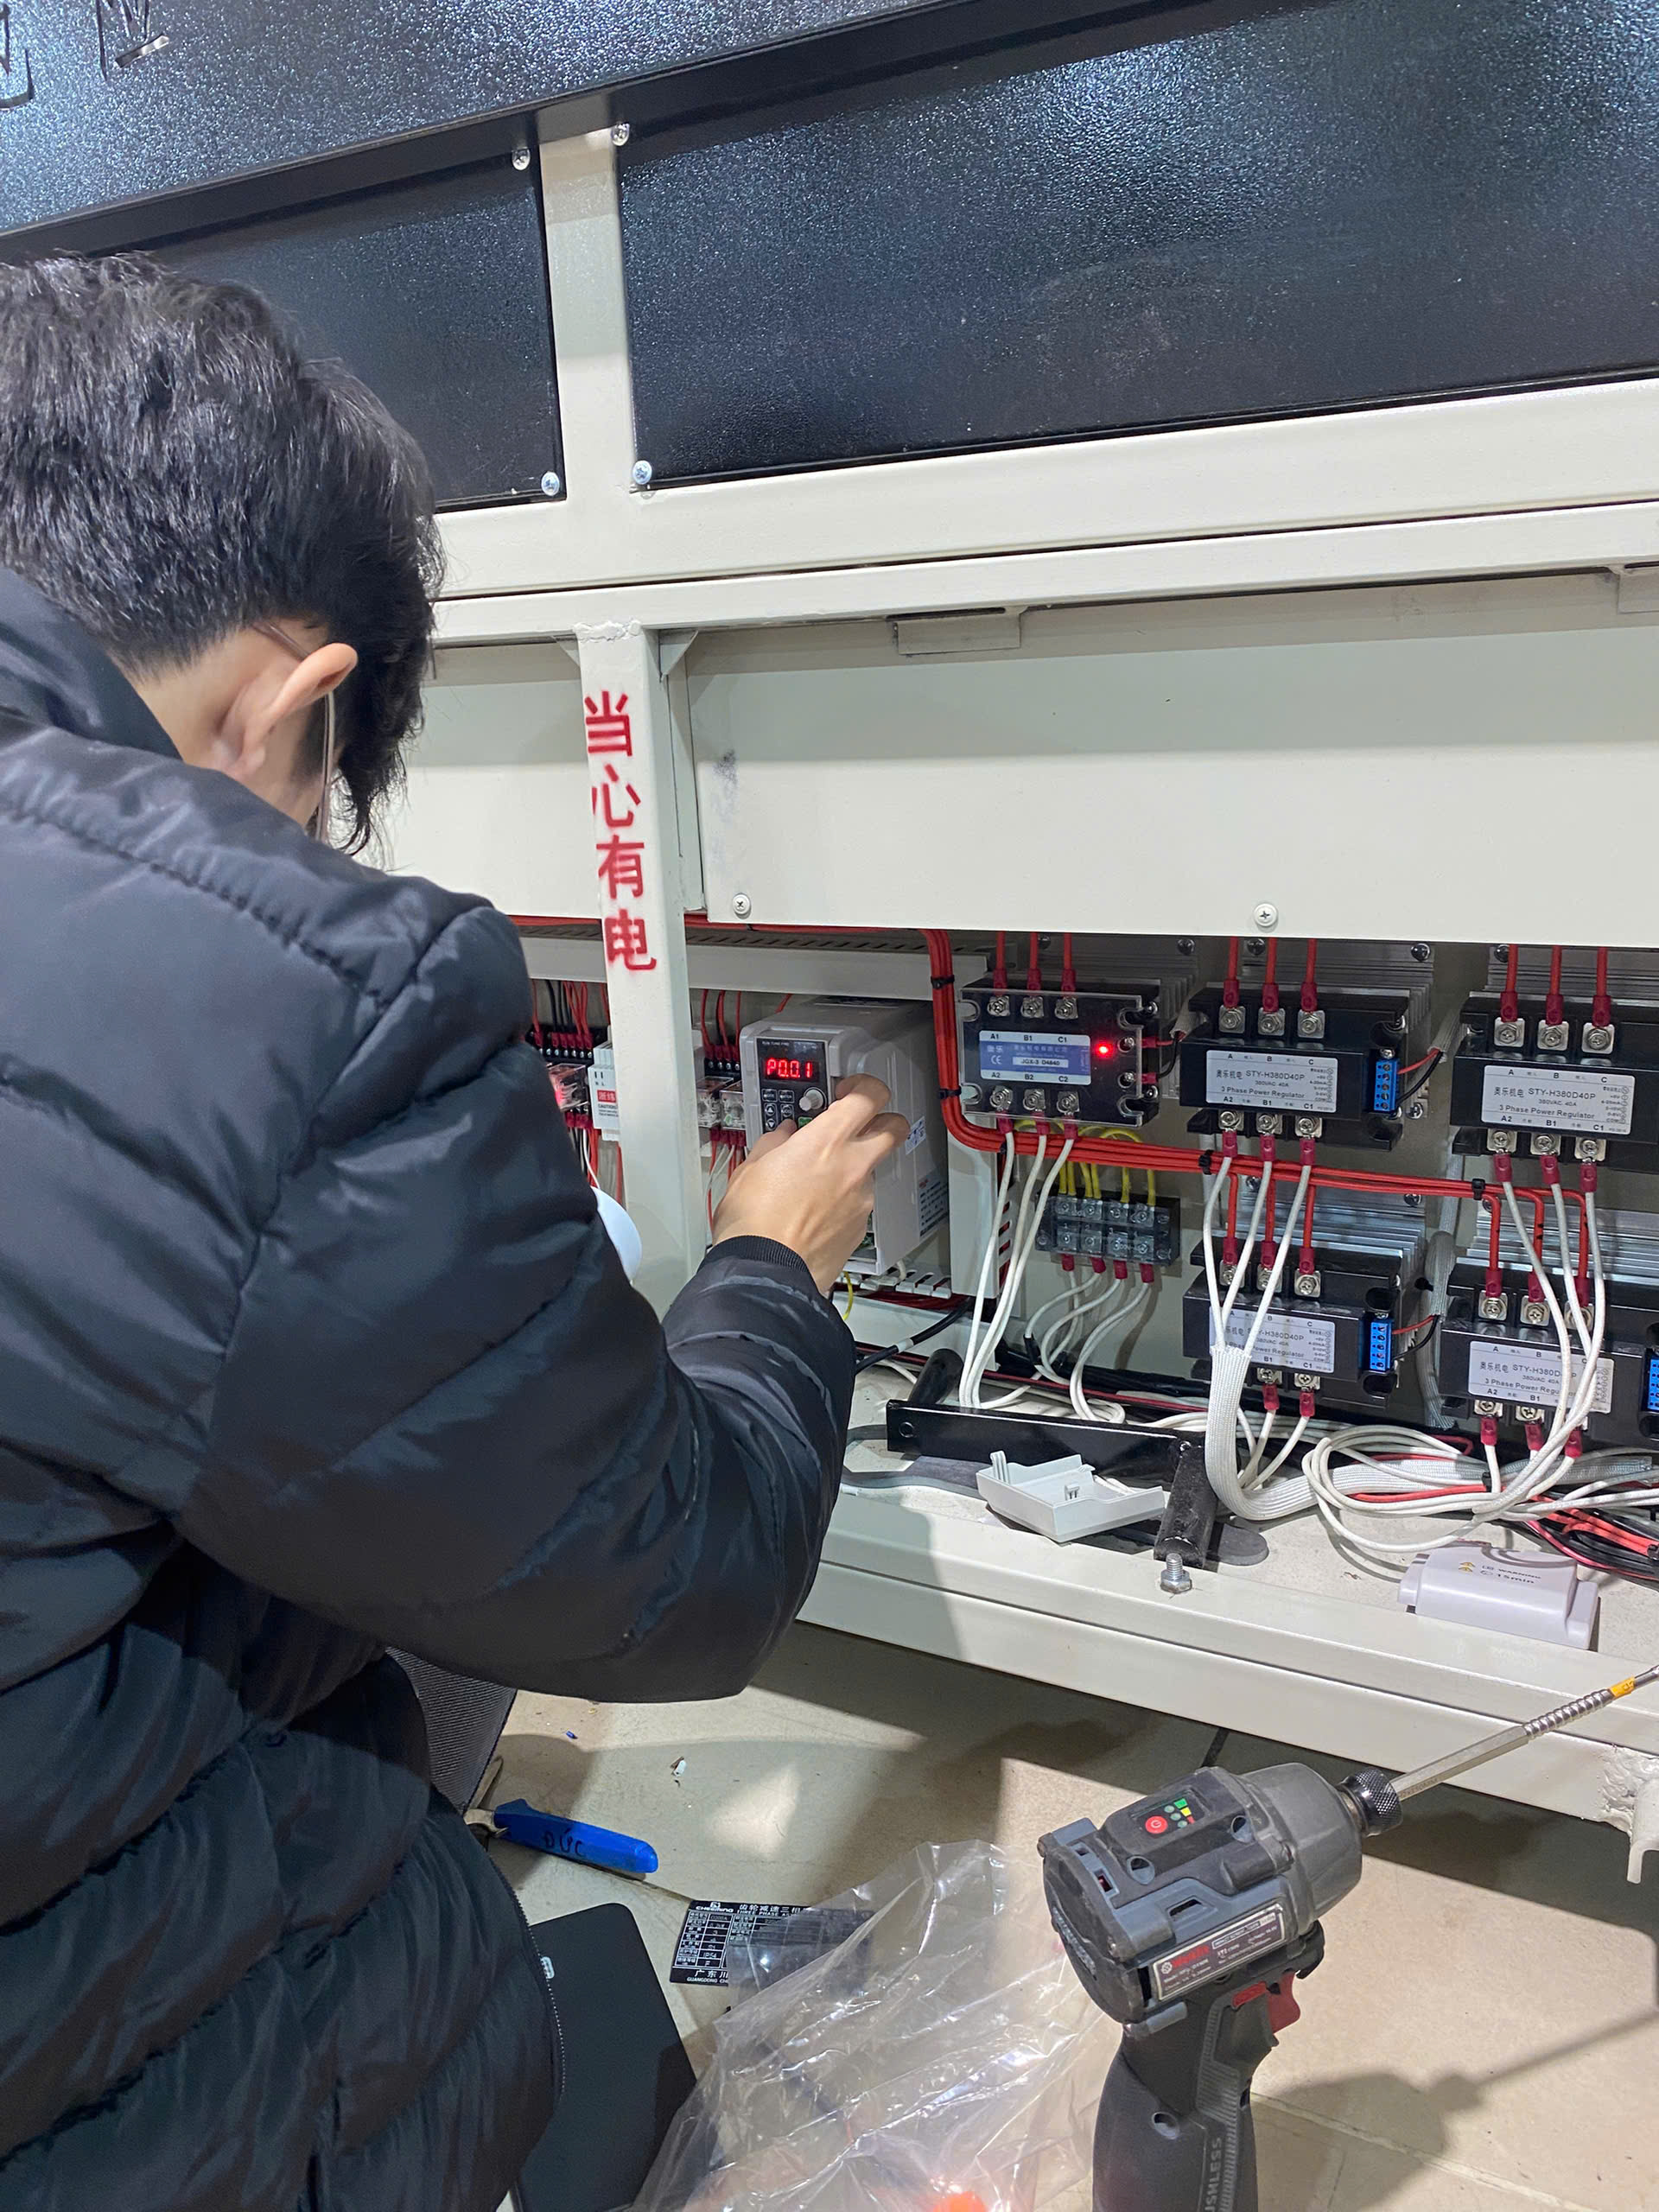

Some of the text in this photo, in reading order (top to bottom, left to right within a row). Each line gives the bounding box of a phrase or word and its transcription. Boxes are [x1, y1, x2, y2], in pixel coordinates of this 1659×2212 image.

[584, 690, 657, 971] 当心有电
[1245, 1070, 1306, 1081] STY-H380D40P
[1272, 1090, 1305, 1098] Regulator
[1528, 1087, 1596, 1100] STY-H380D40P
[1505, 1104, 1529, 1114] Phase
[1530, 1107, 1555, 1116] Power
[1557, 1109, 1595, 1120] Regulator
[1272, 1347, 1305, 1357] Regulator
[1491, 1378, 1513, 1388] Phase
[1515, 1382, 1539, 1391] Power
